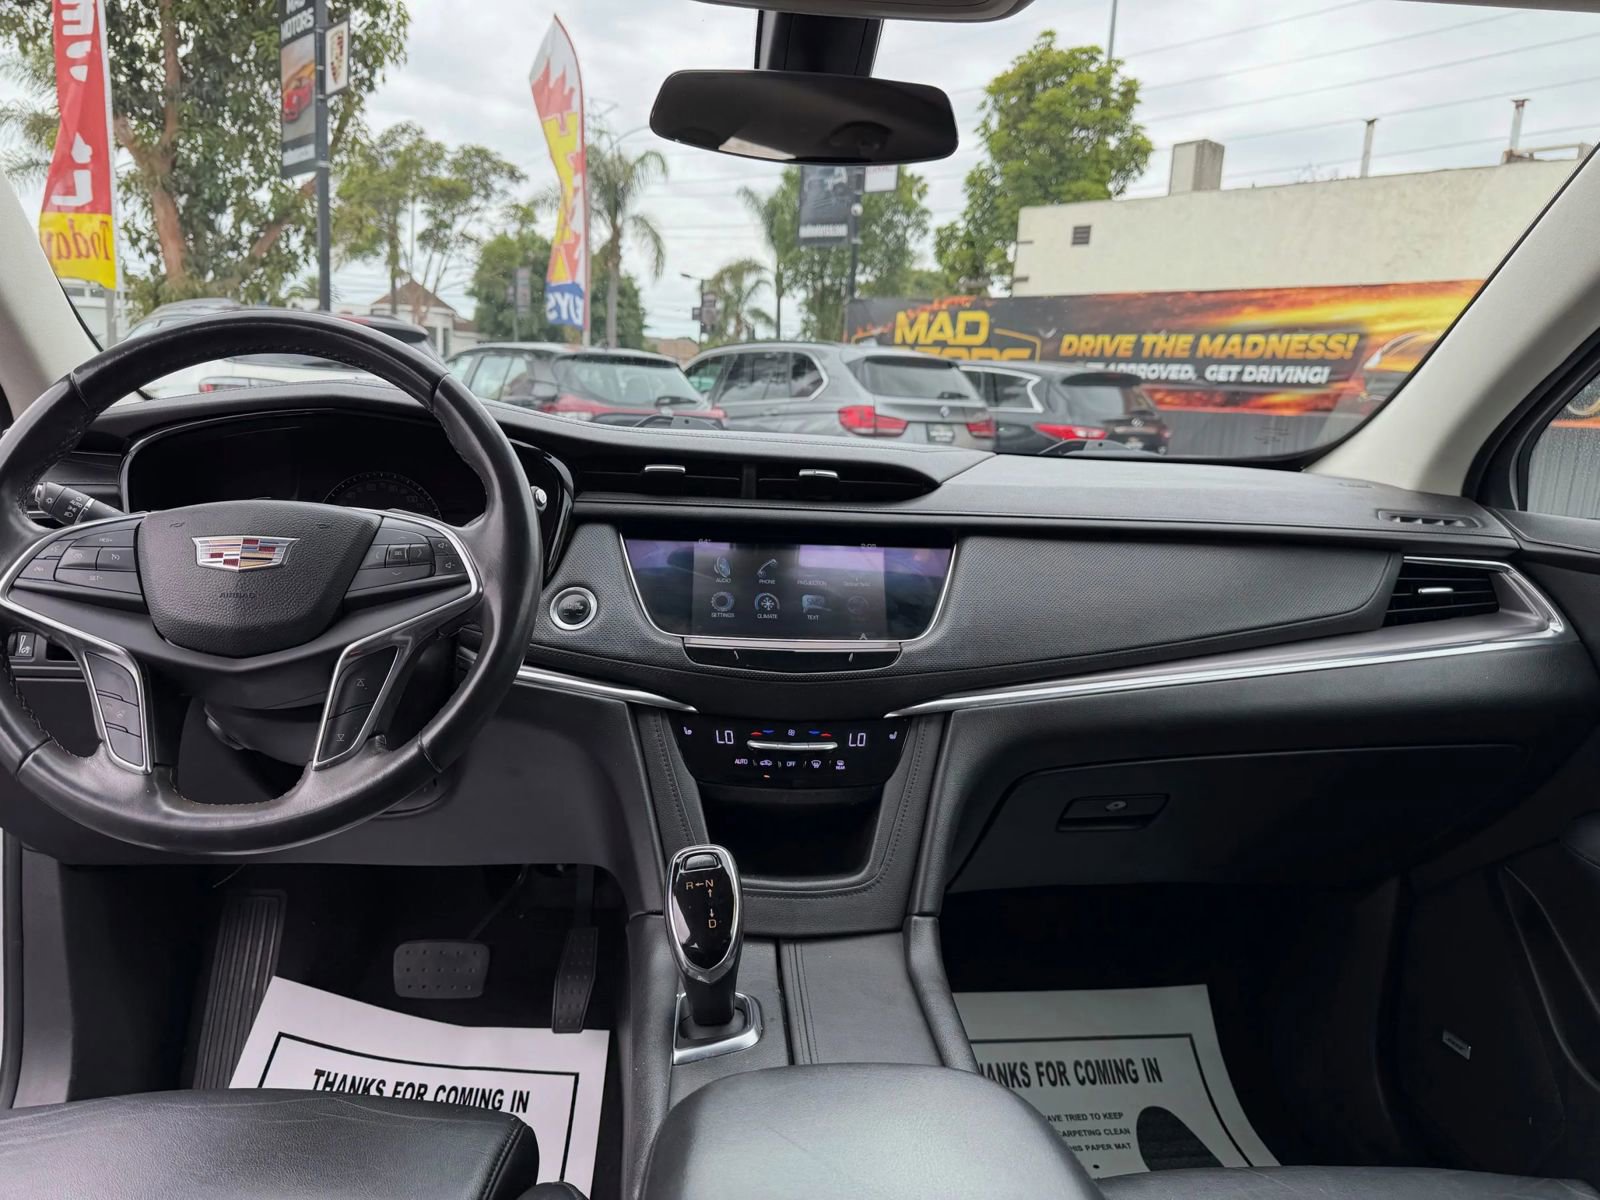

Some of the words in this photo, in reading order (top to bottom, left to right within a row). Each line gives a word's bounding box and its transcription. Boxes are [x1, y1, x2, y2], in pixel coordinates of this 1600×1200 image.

[894, 309, 990, 346] MAD
[1060, 334, 1135, 359] DRIVE
[1141, 333, 1196, 359] THE
[1196, 333, 1360, 361] MADNESS!
[1204, 364, 1241, 384] GET
[1241, 365, 1330, 385] DRIVING!
[715, 729, 734, 745] LO
[848, 732, 866, 747] LO
[685, 881, 694, 890] R
[705, 879, 714, 887] N
[708, 919, 717, 928] D
[1035, 1060, 1070, 1087] FOR
[1073, 1056, 1139, 1086] COMING
[1142, 1056, 1163, 1084] IN
[313, 1068, 387, 1097] THANKS
[392, 1081, 428, 1101] FOR
[433, 1084, 504, 1111] COMING
[510, 1089, 530, 1114] IN
[1044, 1114, 1062, 1122] AVE
[1065, 1113, 1088, 1121] TRIED
[1090, 1112, 1101, 1120] TO
[1103, 1111, 1124, 1120] KEEP
[1103, 1127, 1131, 1136] CLEAN
[1085, 1143, 1113, 1152] PAPER
[1114, 1142, 1132, 1150] MAT
